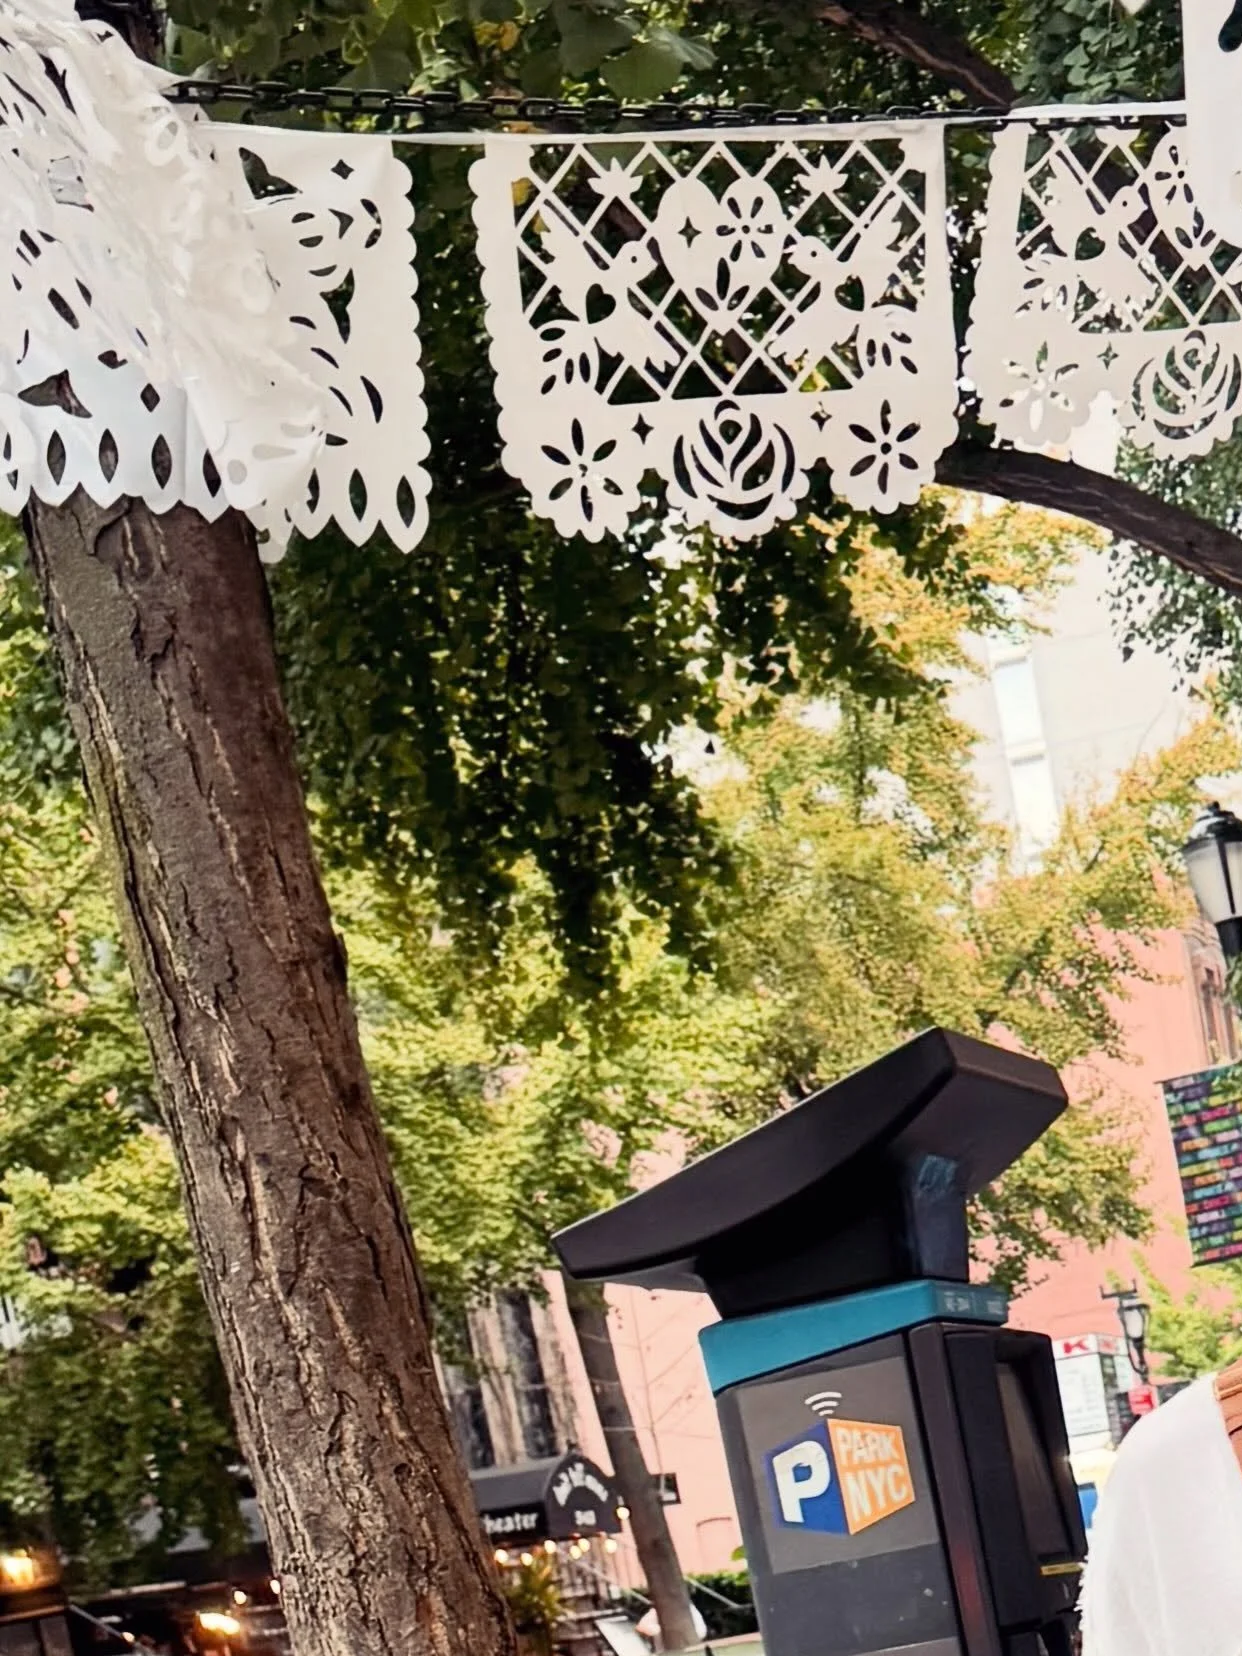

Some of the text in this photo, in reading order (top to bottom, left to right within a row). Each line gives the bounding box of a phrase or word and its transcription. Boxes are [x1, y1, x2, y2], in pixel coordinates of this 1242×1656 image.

[836, 1426, 901, 1467] PARK
[772, 1440, 831, 1523] P
[845, 1465, 909, 1523] NYC
[485, 1511, 539, 1535] heater
